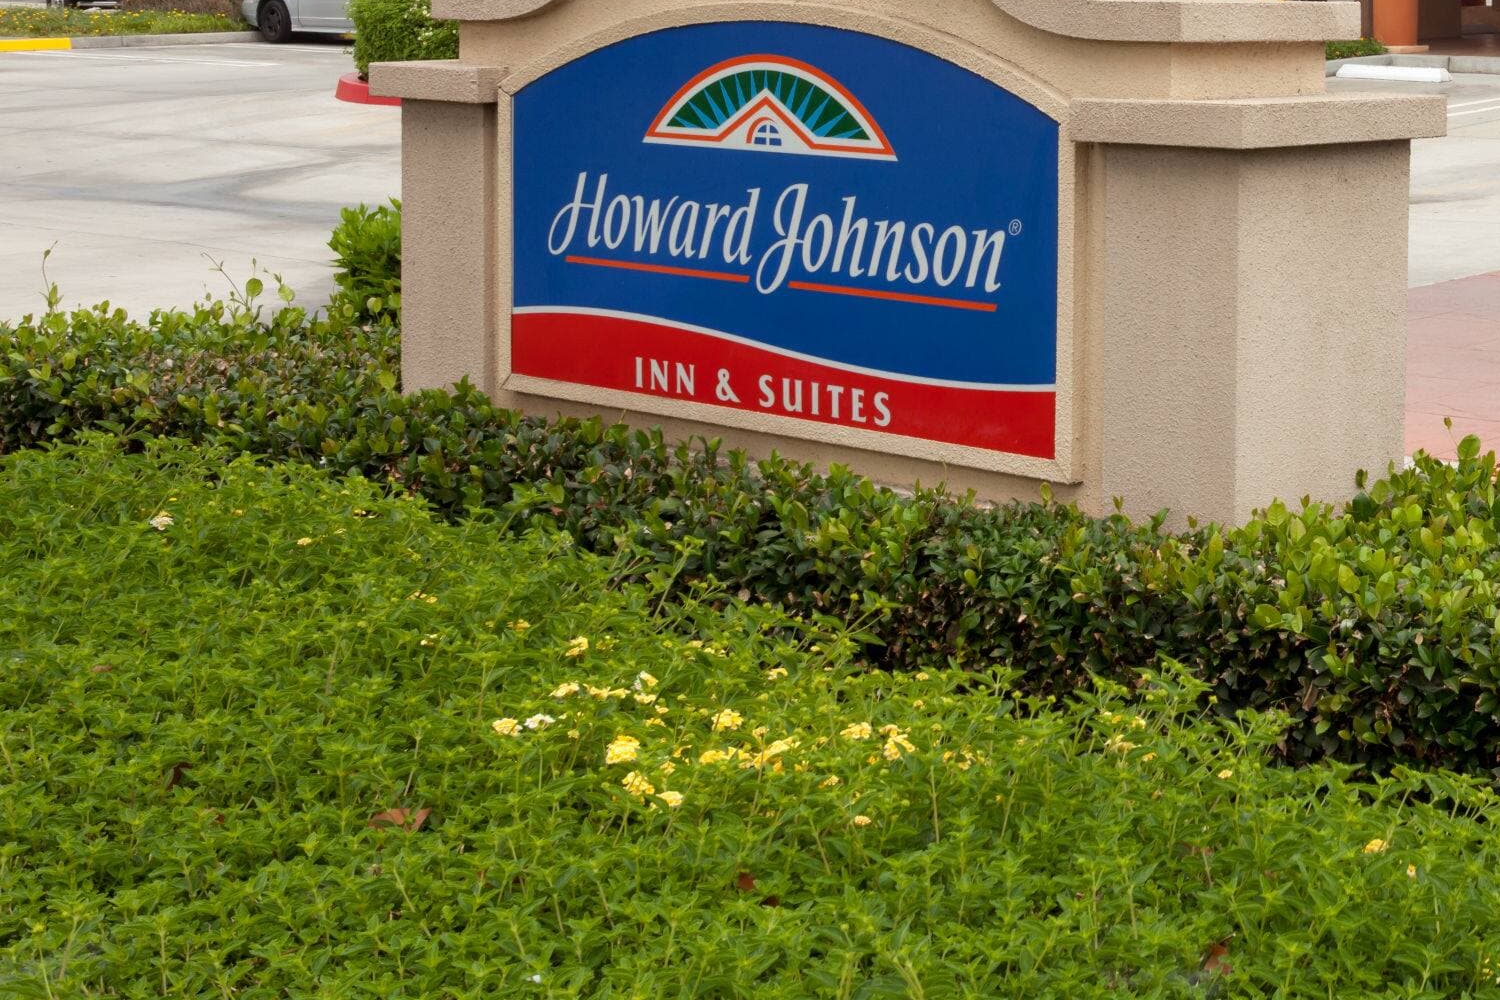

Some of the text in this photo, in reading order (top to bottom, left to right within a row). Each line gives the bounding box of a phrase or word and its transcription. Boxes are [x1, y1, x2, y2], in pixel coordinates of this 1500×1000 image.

[548, 171, 760, 266] Howard
[635, 356, 892, 427] INN & SUITES
